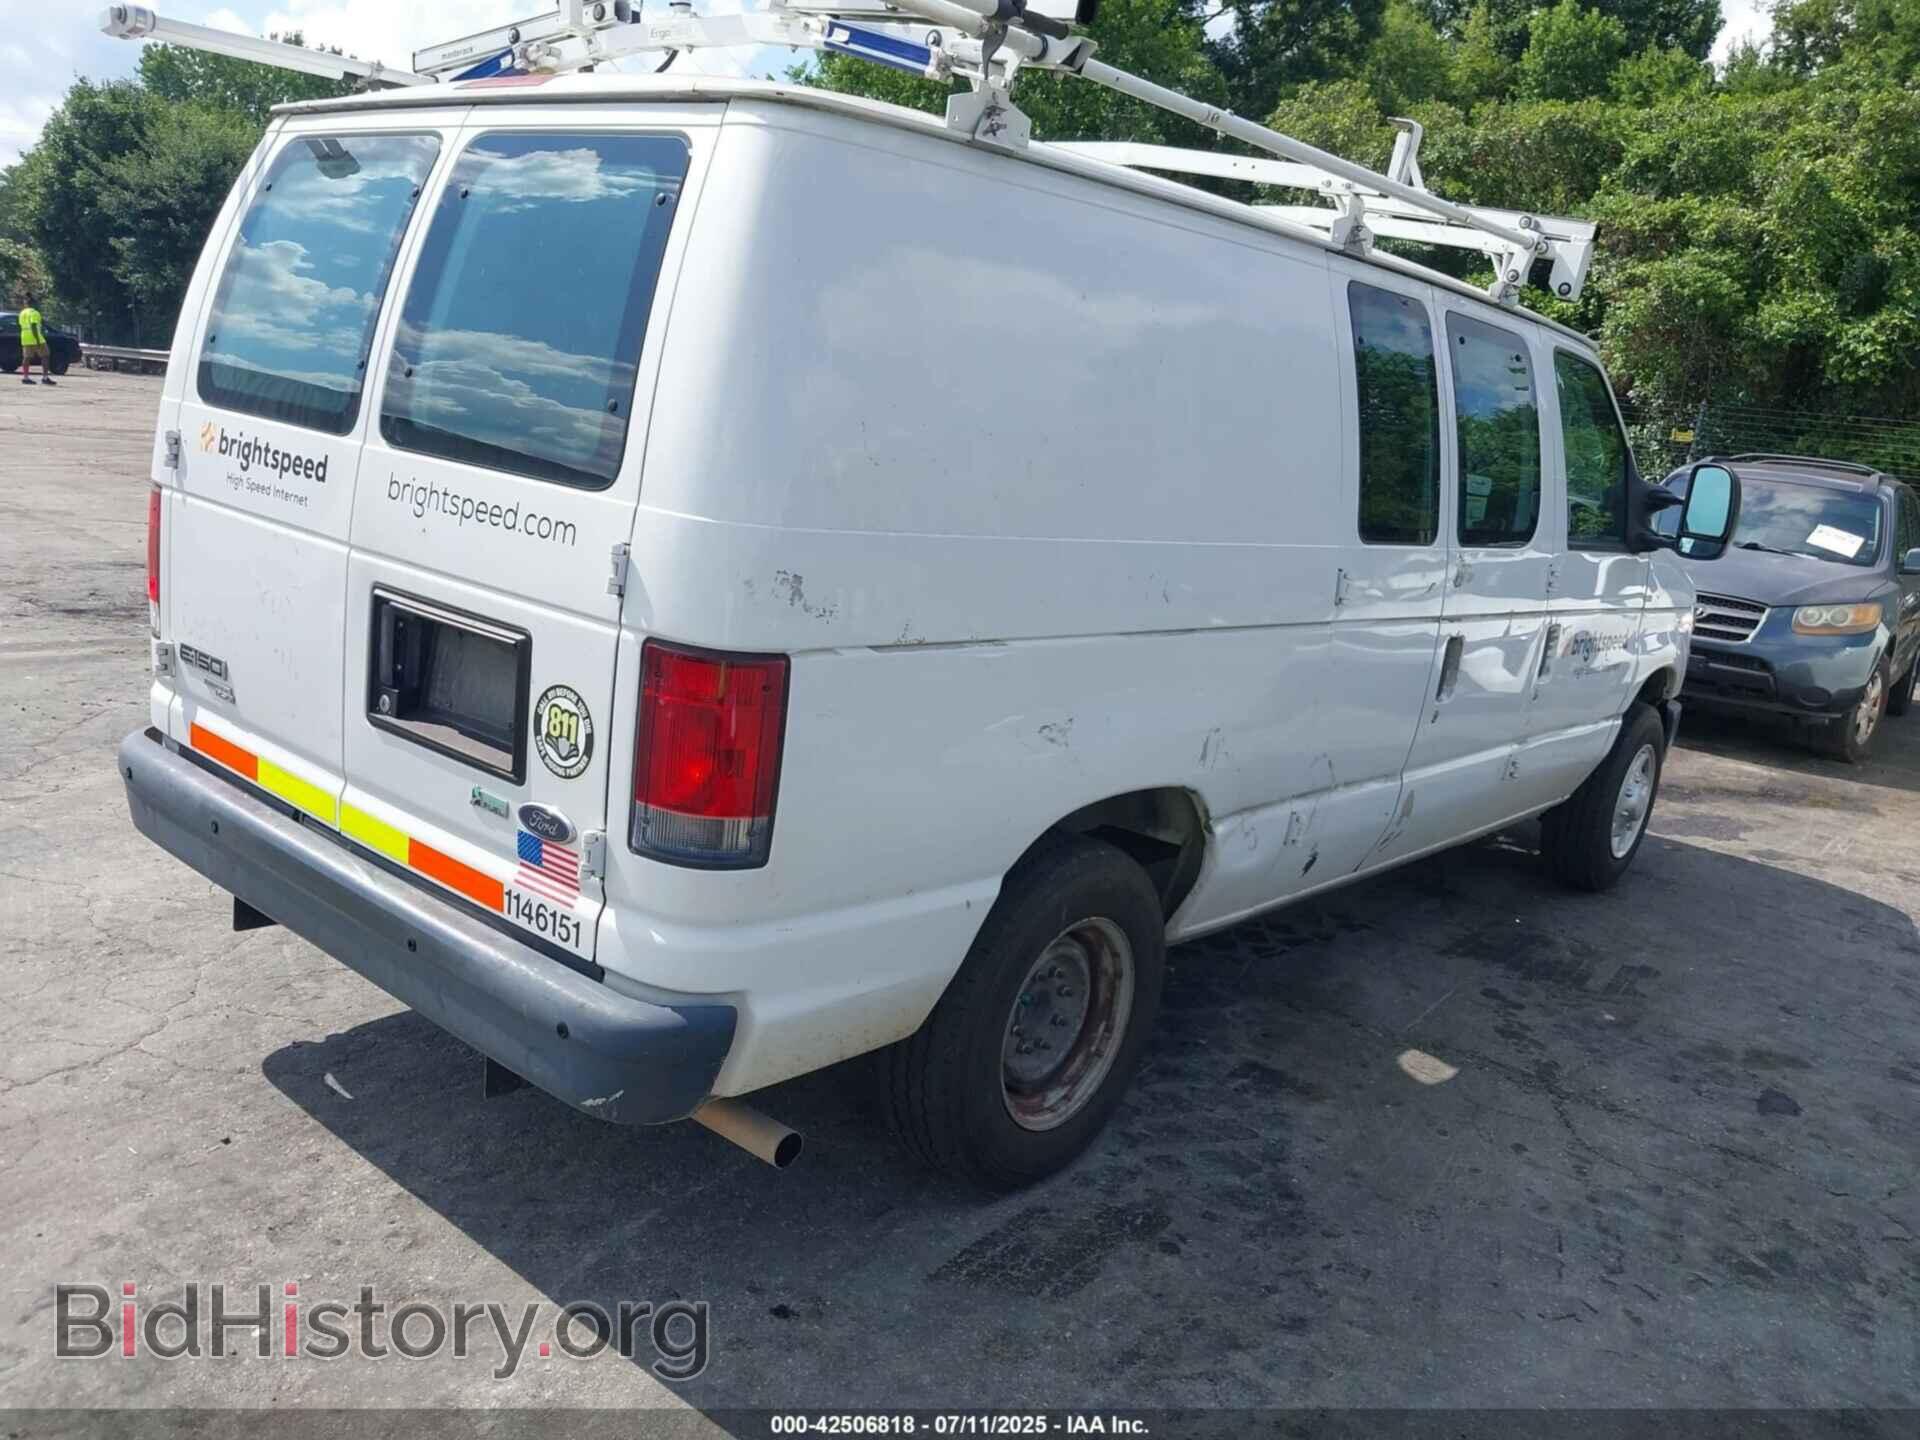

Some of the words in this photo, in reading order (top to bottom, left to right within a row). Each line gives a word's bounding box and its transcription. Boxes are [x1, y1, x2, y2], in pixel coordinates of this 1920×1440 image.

[218, 427, 328, 483] brightspeed
[226, 472, 244, 490] High
[245, 477, 271, 495] Speed
[273, 485, 308, 507] Internet
[387, 472, 577, 546] brightspeed.com
[549, 704, 579, 745] 811
[529, 809, 560, 836] Ford
[505, 888, 581, 948] 1146151
